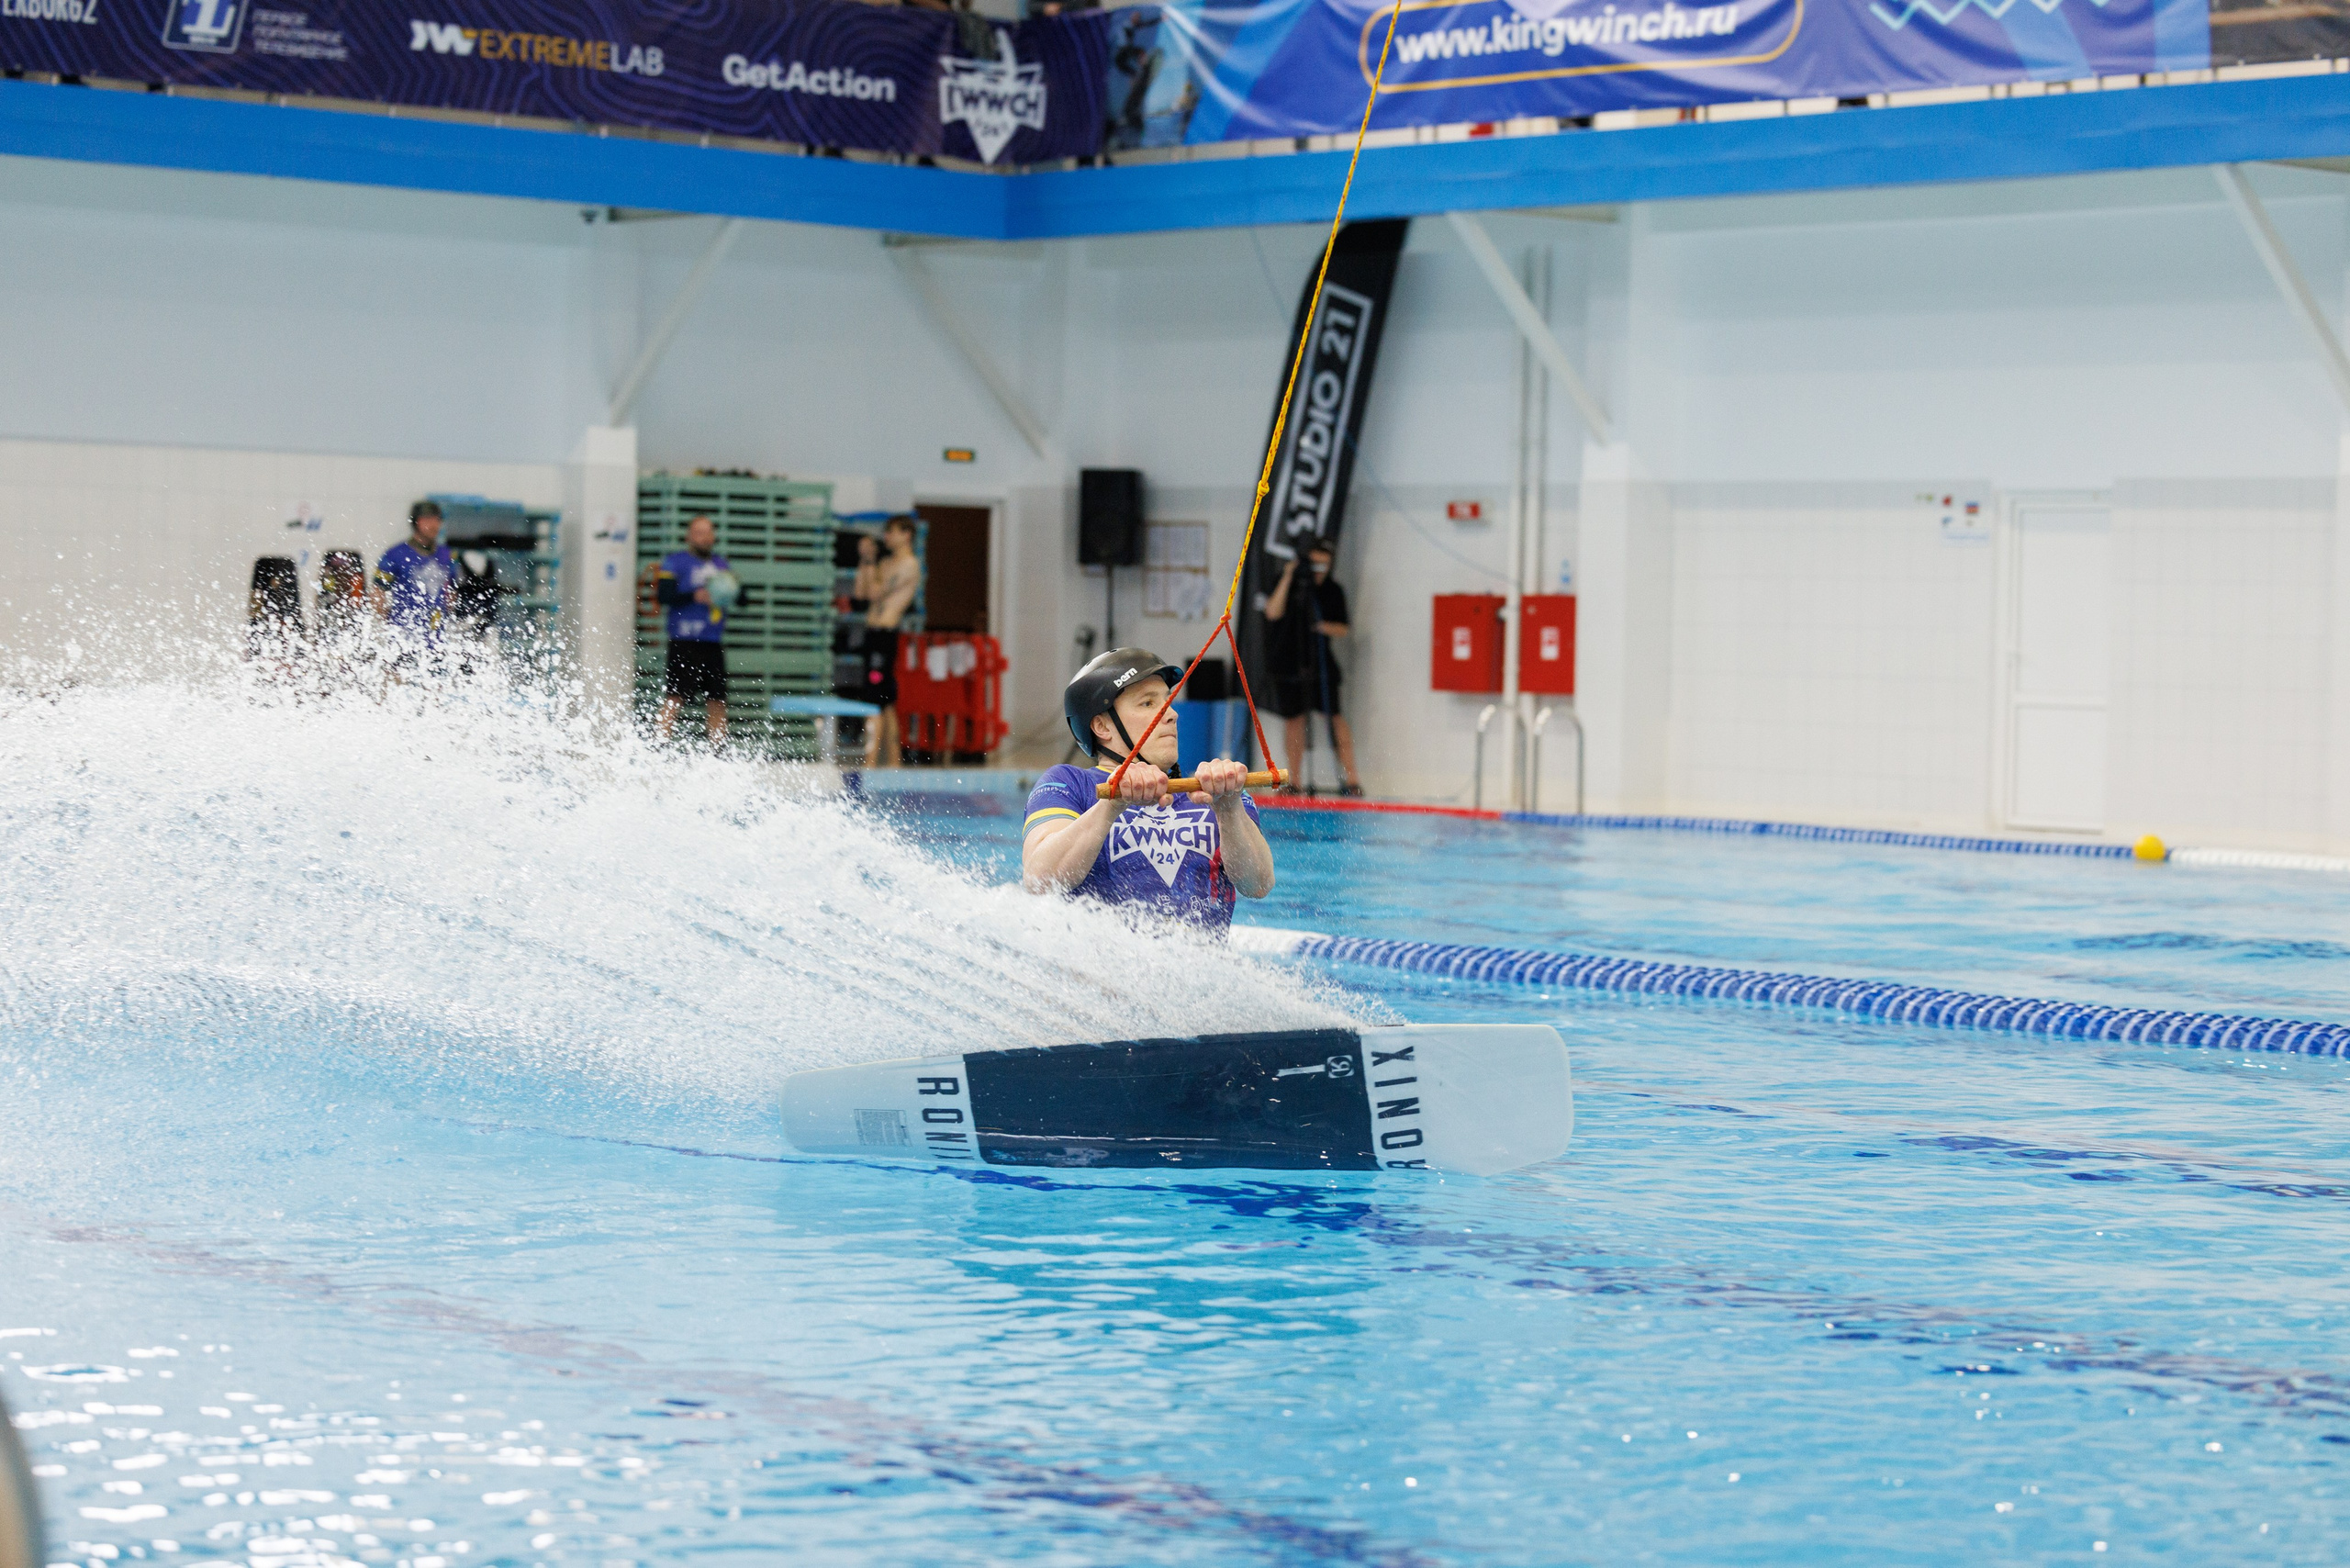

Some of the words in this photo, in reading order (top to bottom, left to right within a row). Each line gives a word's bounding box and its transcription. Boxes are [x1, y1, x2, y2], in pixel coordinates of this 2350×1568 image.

[1394, 4, 1738, 62] www.kingwinch.ru
[722, 54, 897, 103] GetAction
[1286, 369, 1342, 537] STUDIO
[1321, 307, 1357, 363] 21
[1113, 666, 1138, 689] bern
[1113, 824, 1213, 857] KWWCH
[917, 1077, 975, 1160] RONIX
[1371, 1046, 1429, 1170] RONIX
